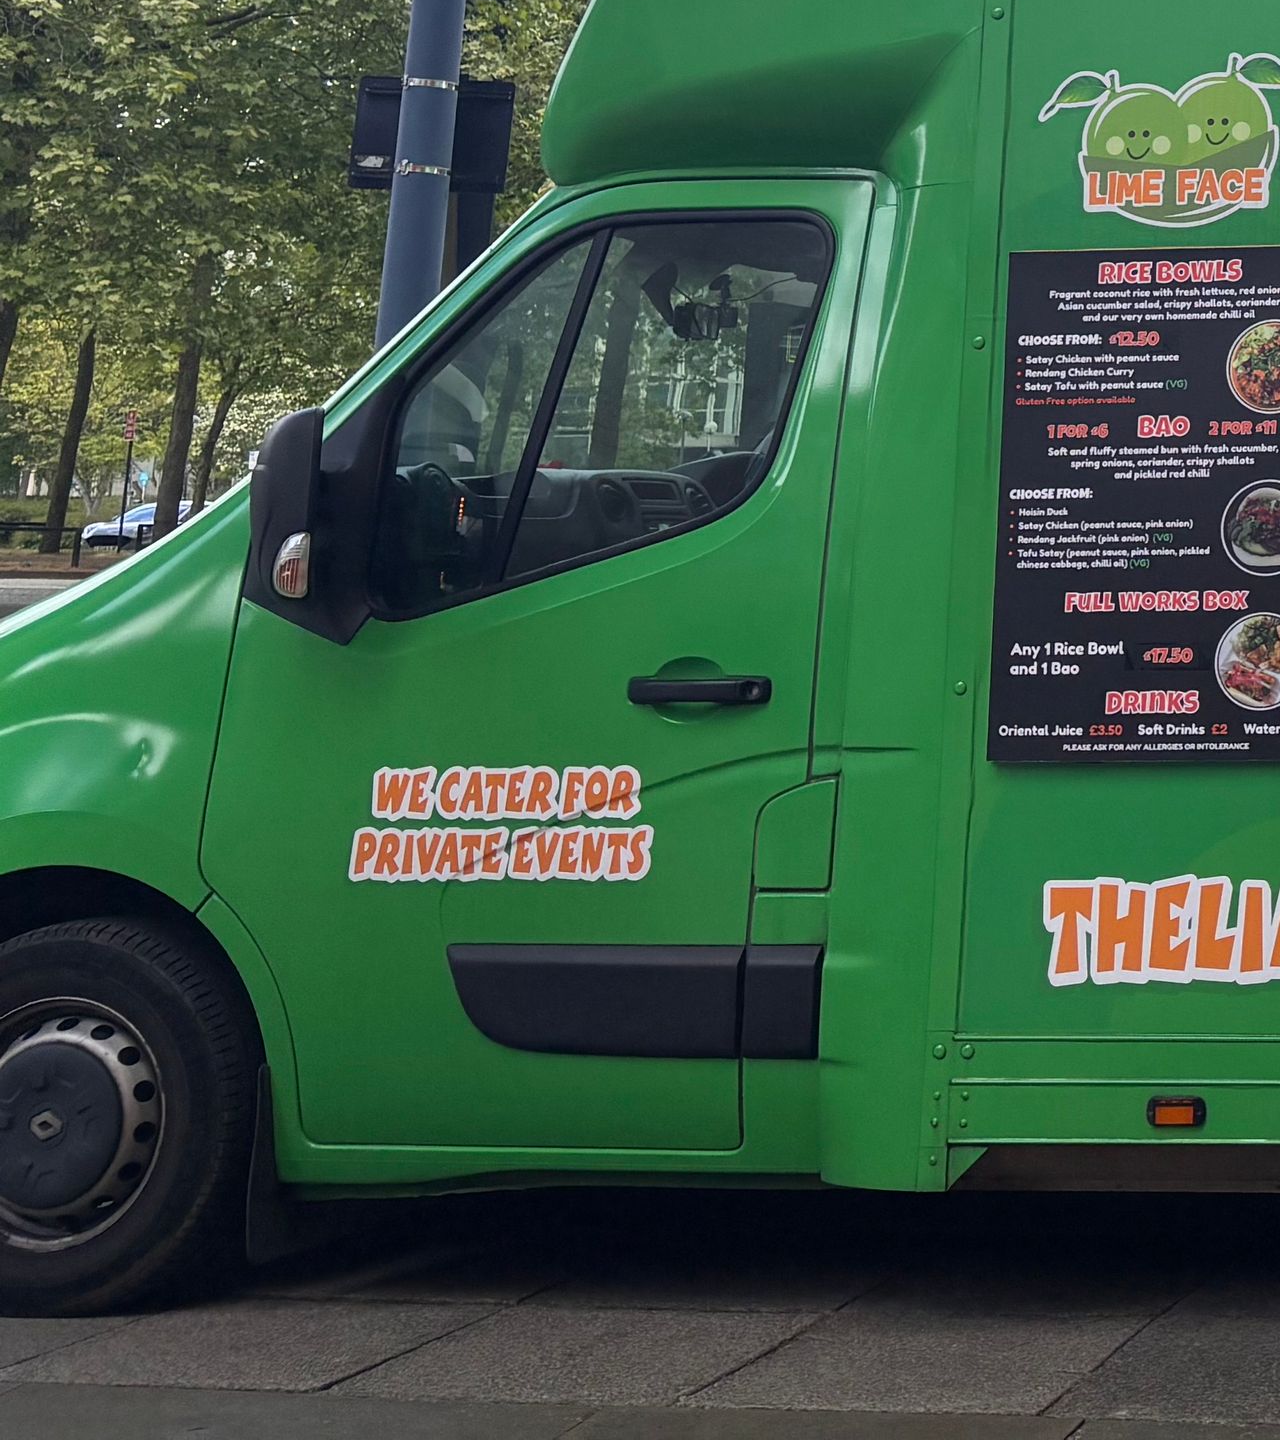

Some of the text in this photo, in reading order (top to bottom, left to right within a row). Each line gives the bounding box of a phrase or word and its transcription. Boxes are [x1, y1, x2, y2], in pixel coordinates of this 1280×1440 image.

[1087, 166, 1267, 207] LIME FACE
[1098, 259, 1243, 284] RICE BOWLS
[1049, 290, 1091, 300] Fragrant
[1093, 289, 1131, 298] coconut
[1133, 289, 1151, 297] rice
[1153, 288, 1173, 297] with
[1175, 287, 1200, 296] fresh
[1202, 287, 1237, 297] lettuce,
[1239, 286, 1255, 295] red
[1058, 297, 1280, 310] Asian cucumber salad, crispy shallots, coriander
[1082, 310, 1255, 323] and our very own homemade chilli oil
[1018, 334, 1102, 346] CHOOSE FROM:
[1025, 353, 1179, 366] Satay Chicken with peanut sauce
[1025, 368, 1134, 379] Rendang Chicken Curry
[1025, 379, 1188, 392] Satay Tofu with peanut sauce (VG)
[1016, 396, 1136, 407] Gluten Free option available
[1057, 424, 1088, 438] FOR
[1137, 415, 1190, 438] BAO
[1208, 422, 1218, 436] 2
[1221, 421, 1252, 435] FOR
[1048, 444, 1279, 457] Soft and fluffy steamed bun with fresh cucumber,
[1071, 456, 1254, 469] spring onions, coriander, crispy shallots
[1114, 469, 1210, 480] and pickled red chilli
[1010, 488, 1093, 499] CHOOSE FROM:
[1019, 508, 1068, 517] Hoisin Duck
[1018, 519, 1193, 531] Satay Chicken (peanut sauce, pink onion)
[1017, 533, 1173, 545] Rendang Jackfruit (pink onion) (VG)
[1039, 549, 1065, 559] Satay
[1066, 548, 1101, 558] (peanut
[1102, 549, 1129, 557] sauce,
[1131, 547, 1149, 556] pink
[1151, 548, 1177, 556] onion,
[1179, 546, 1210, 555] pickled
[1051, 560, 1089, 569] cabbage,
[1091, 559, 1111, 568] chilli
[1113, 559, 1128, 568] oil)
[1129, 559, 1150, 568] (VG)
[1064, 590, 1249, 612] FULL WORKS BOX
[1010, 641, 1124, 659] Any 1 Rice Bowl
[1010, 662, 1079, 675] and 1 Bao
[1105, 690, 1200, 715] DRINKS
[998, 724, 1123, 737] Oriental Juice £3.50
[1138, 723, 1228, 736] Soft Drinks £2
[1063, 743, 1091, 751] PLEASE
[1093, 743, 1107, 751] ASK
[1109, 743, 1124, 751] FOR
[1125, 743, 1141, 751] ANY
[1143, 743, 1183, 751] ALLERGIES
[1197, 742, 1250, 750] INTOLERANCE
[376, 769, 635, 815] WE CATER FOR
[353, 829, 647, 876] PRIVATE EVENTS
